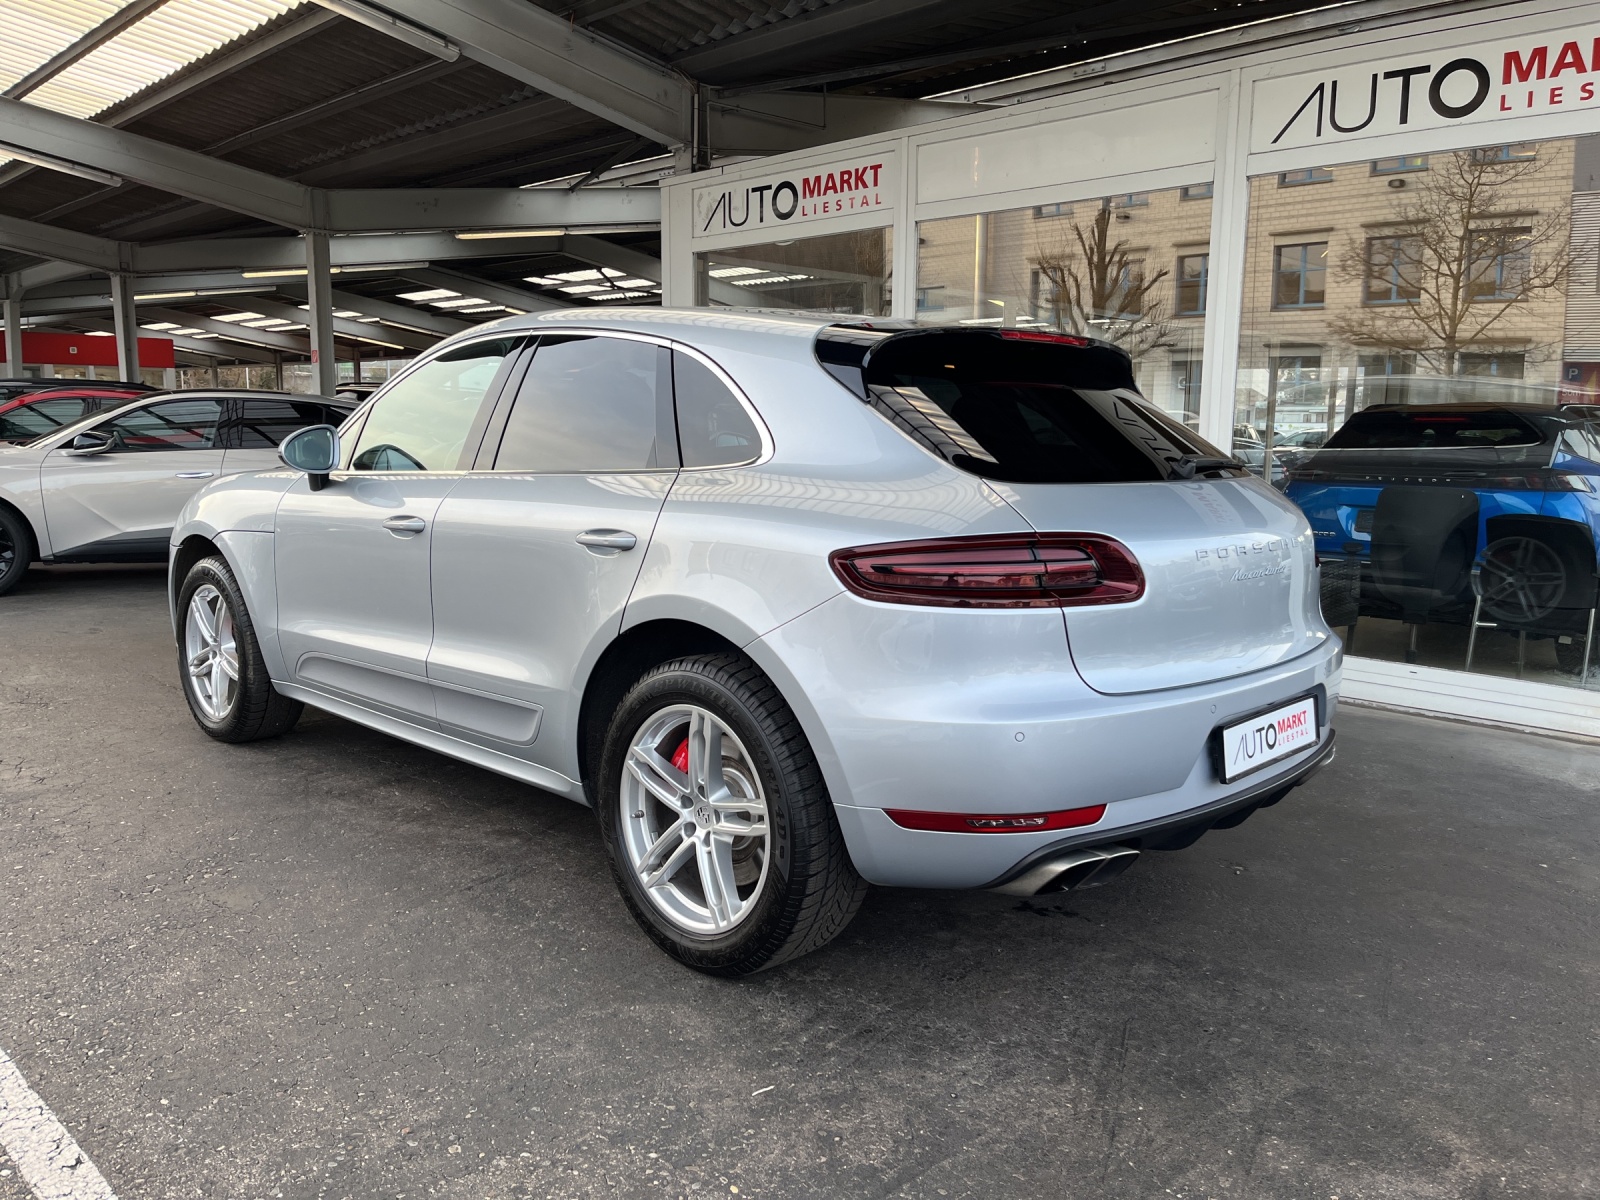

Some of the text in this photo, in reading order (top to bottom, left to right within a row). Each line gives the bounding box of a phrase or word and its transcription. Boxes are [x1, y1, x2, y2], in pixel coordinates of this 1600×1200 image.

[1271, 57, 1491, 144] AUTO
[1500, 81, 1595, 112] LIES
[703, 163, 883, 232] AUTO MARKT
[801, 192, 882, 217] LIESTAL
[1195, 537, 1299, 562] PORSCHE
[1233, 710, 1307, 766] AUTO MARKT
[1278, 727, 1309, 746] LIESTAL
